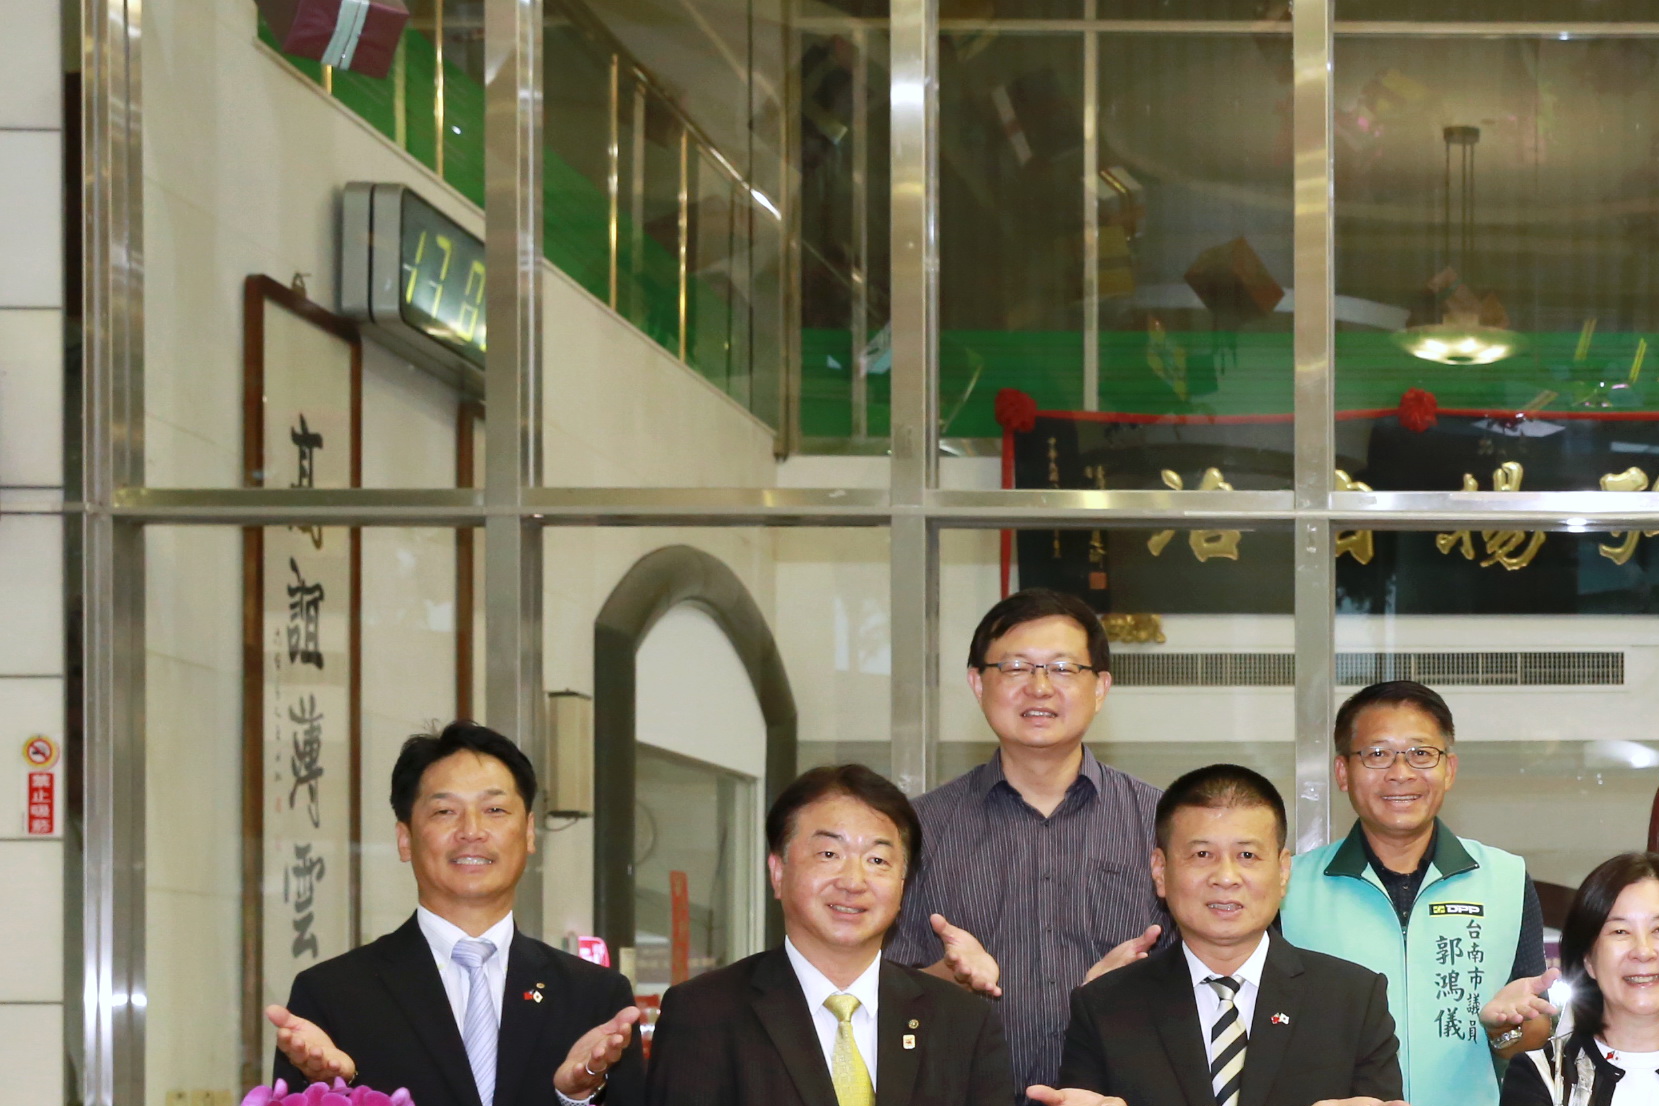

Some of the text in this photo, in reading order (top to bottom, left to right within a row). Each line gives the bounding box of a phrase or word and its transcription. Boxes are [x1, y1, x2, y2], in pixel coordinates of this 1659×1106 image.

[1446, 904, 1480, 914] DPP
[1434, 935, 1465, 1041] 郭鴻儀
[1466, 919, 1485, 1044] 台南市議員
